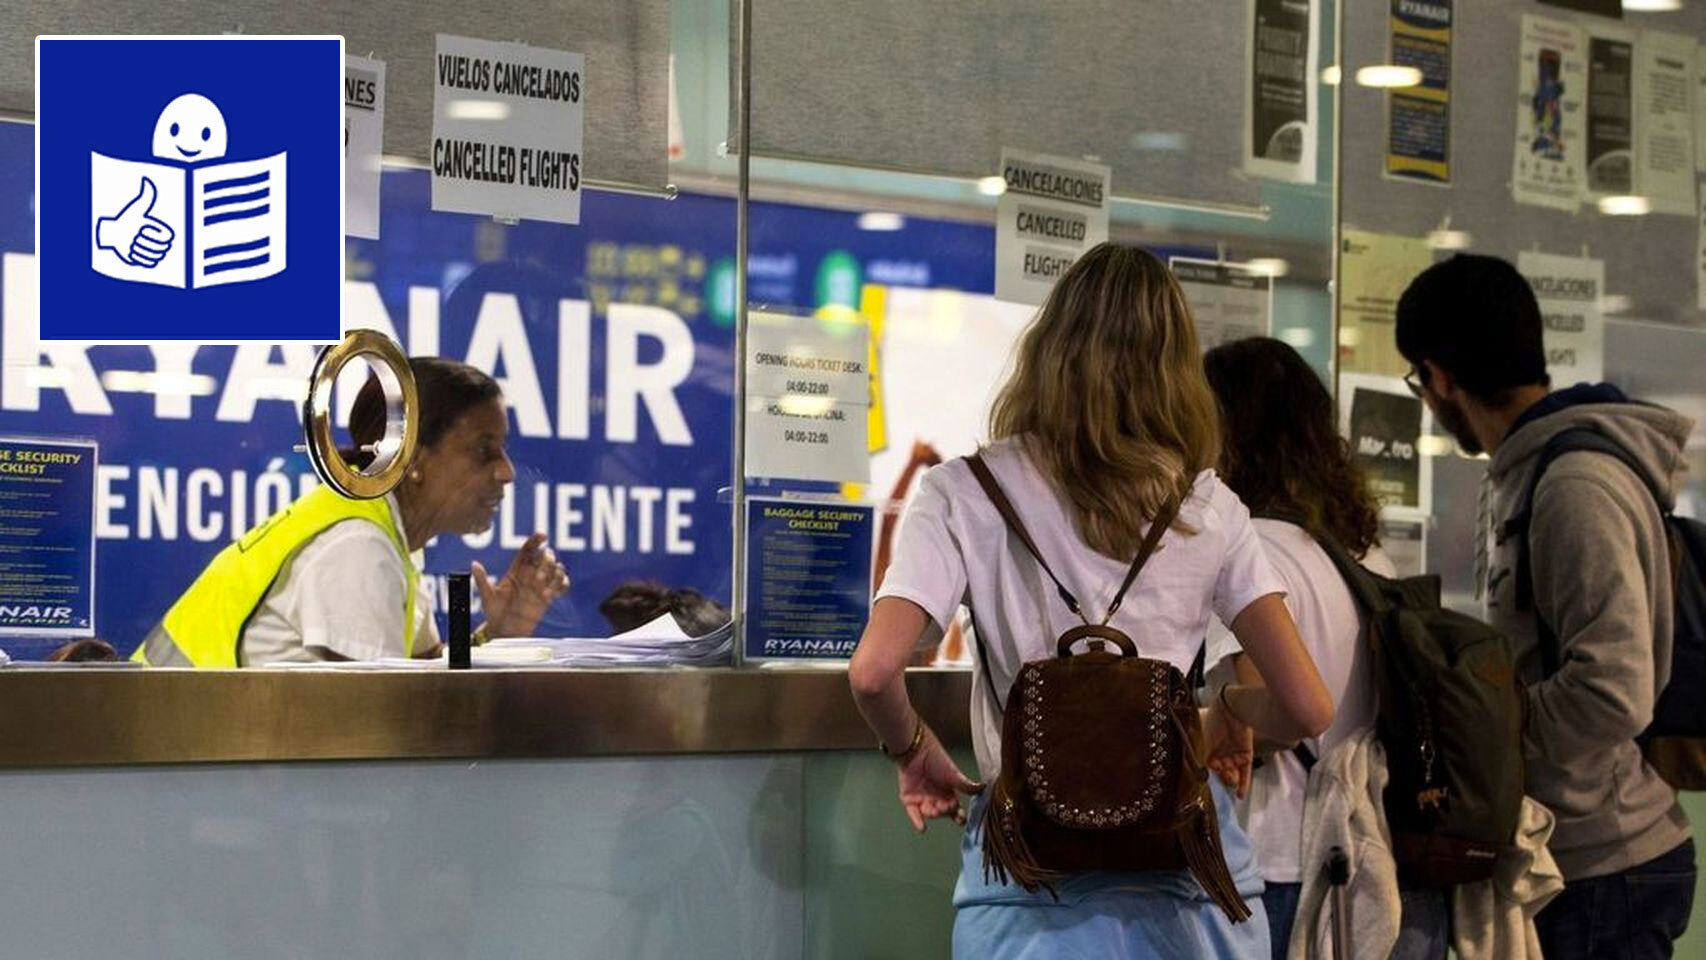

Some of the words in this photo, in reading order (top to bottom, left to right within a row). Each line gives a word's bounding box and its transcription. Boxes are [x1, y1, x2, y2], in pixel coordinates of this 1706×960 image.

[438, 54, 490, 92] VUELOS
[494, 62, 580, 103] CANCELADOS
[433, 138, 516, 184] CANCELLED
[520, 148, 579, 191] FLIGHTS
[1003, 166, 1103, 202] CANCELACIONES
[1016, 212, 1086, 241] CANCELLED
[1024, 253, 1073, 276] FLIGHT
[755, 352, 788, 367] OPENING
[16, 451, 81, 464] SECURITY
[764, 508, 815, 519] BAGGAGE
[818, 511, 864, 521] SECURITY
[764, 639, 856, 651] RYANAIR
